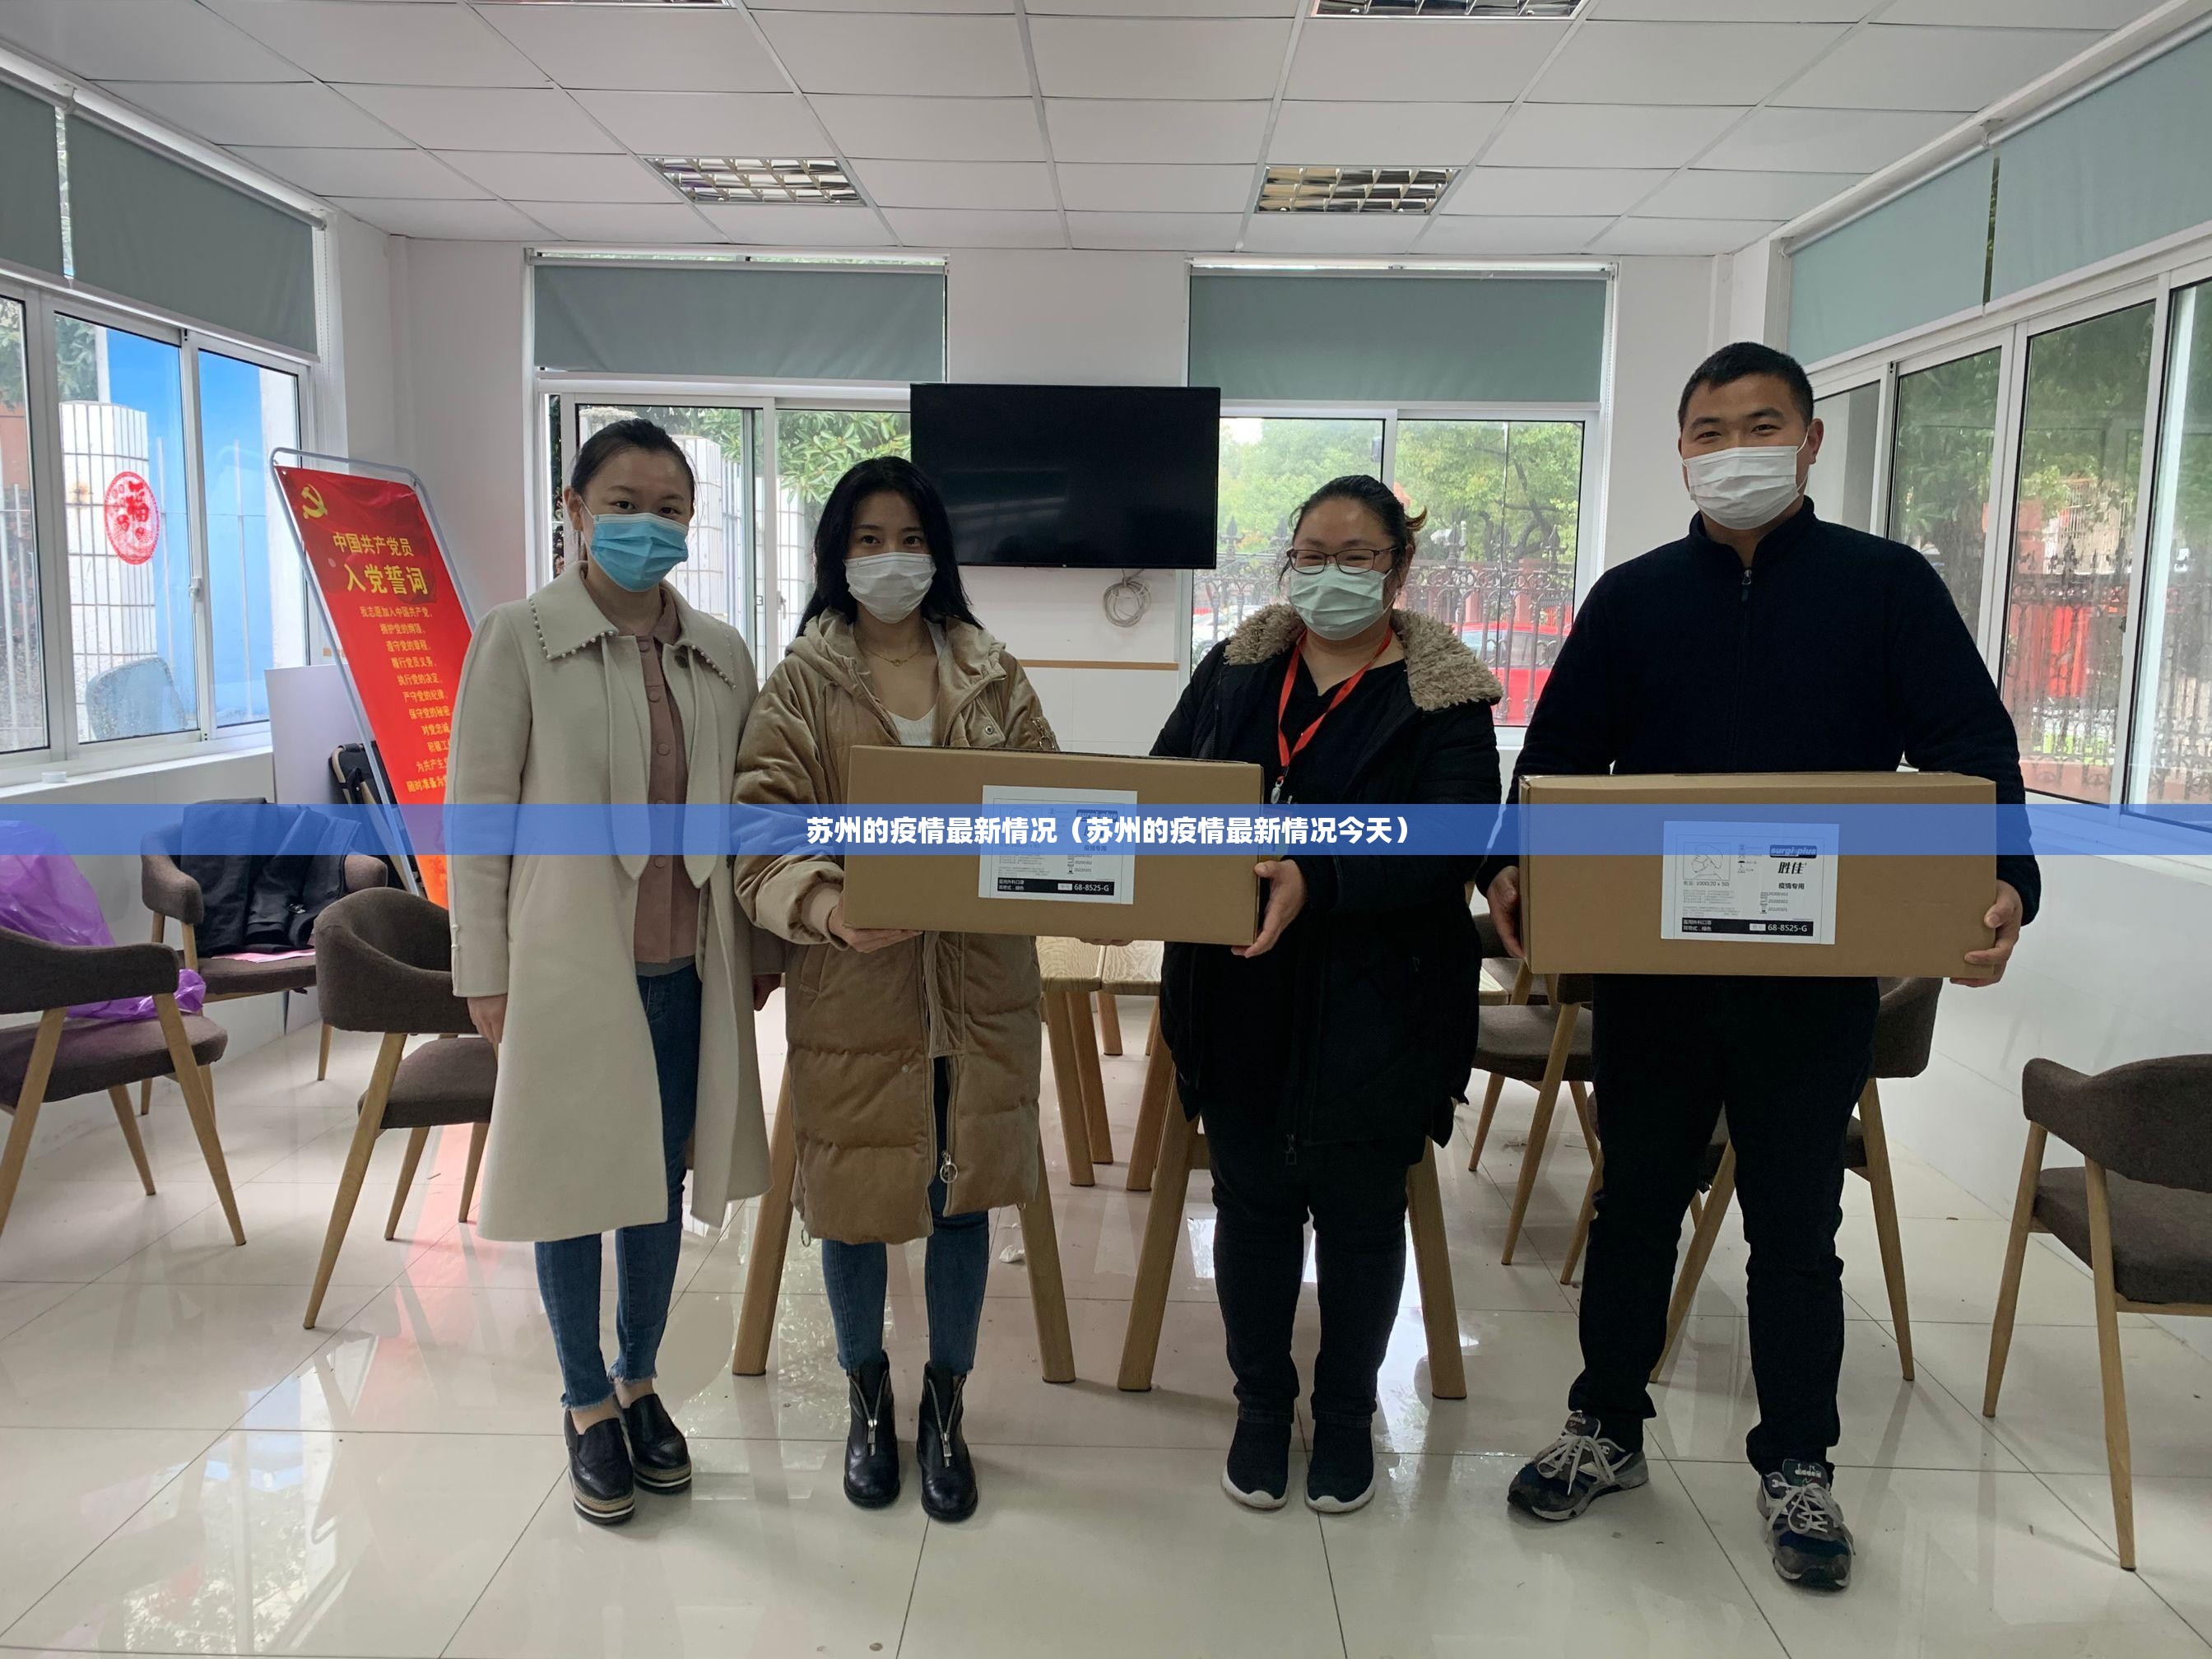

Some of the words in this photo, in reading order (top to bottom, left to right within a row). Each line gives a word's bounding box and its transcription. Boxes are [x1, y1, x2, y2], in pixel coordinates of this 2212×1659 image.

[332, 532, 414, 557] 中国共产党员
[343, 563, 429, 595] 入党誓词
[1074, 883, 1109, 892] 68-8525-G
[1768, 923, 1808, 932] 68-8525-G
